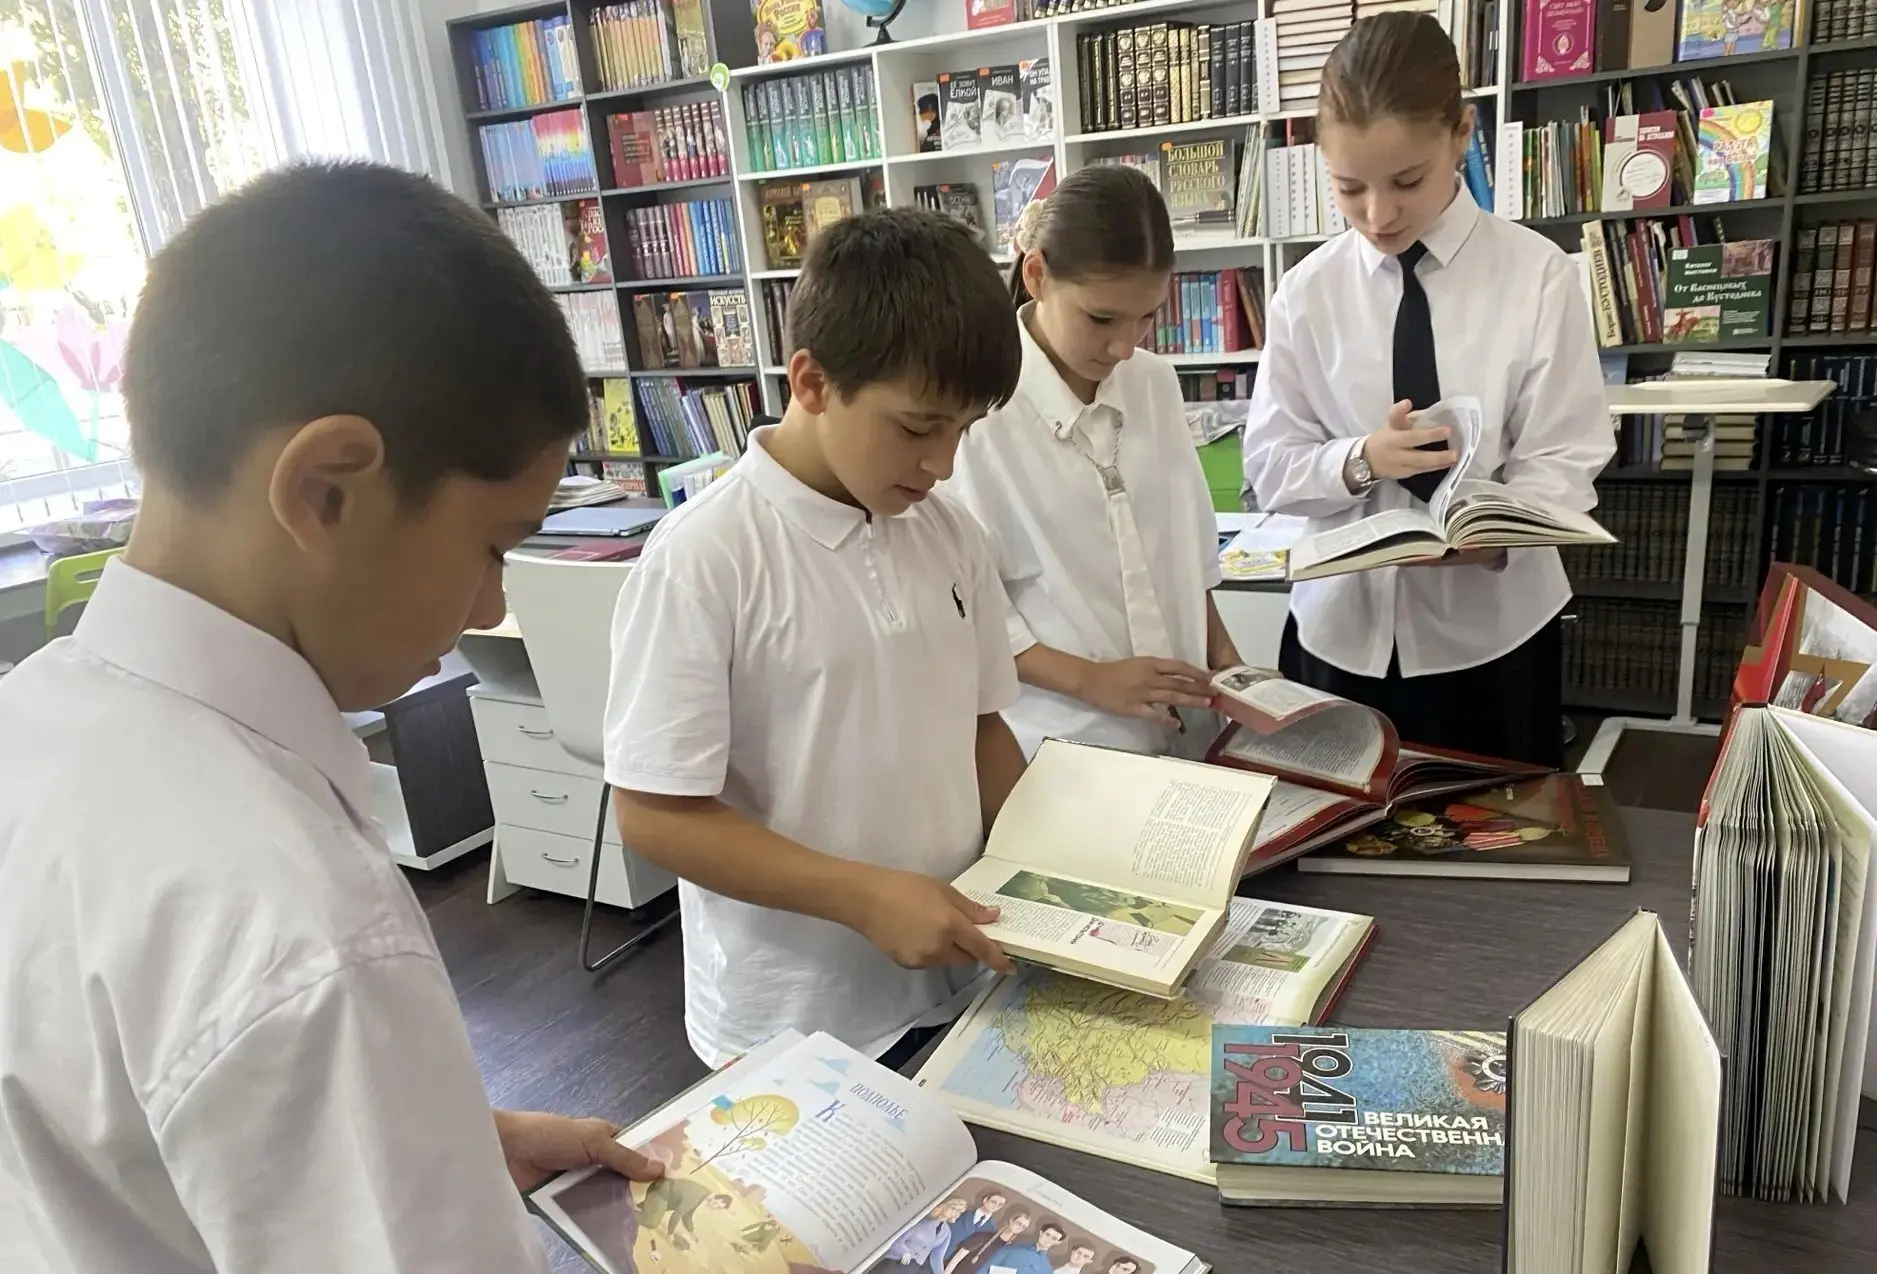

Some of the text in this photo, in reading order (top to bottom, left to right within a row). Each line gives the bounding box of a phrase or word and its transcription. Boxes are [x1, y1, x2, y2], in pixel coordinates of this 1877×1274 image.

[991, 75, 1014, 86] ИВАН
[1168, 142, 1225, 163] БОЛЬШОЙ
[1168, 160, 1218, 178] СЛОВАРЬ
[1170, 175, 1226, 193] РУССКОГО
[1593, 248, 1612, 313] КУСТОДИЕВ
[1674, 281, 1748, 293] От Васнецовых
[1692, 290, 1763, 304] до Кустодиева
[1272, 1033, 1359, 1126] 1941
[1223, 1042, 1308, 1154] 1945
[1363, 1111, 1489, 1131] ВЕЛИКАЯ
[1315, 1124, 1504, 1147] ОТЕЧЕСТВЕНН
[1316, 1139, 1416, 1159] ВОЙНА
